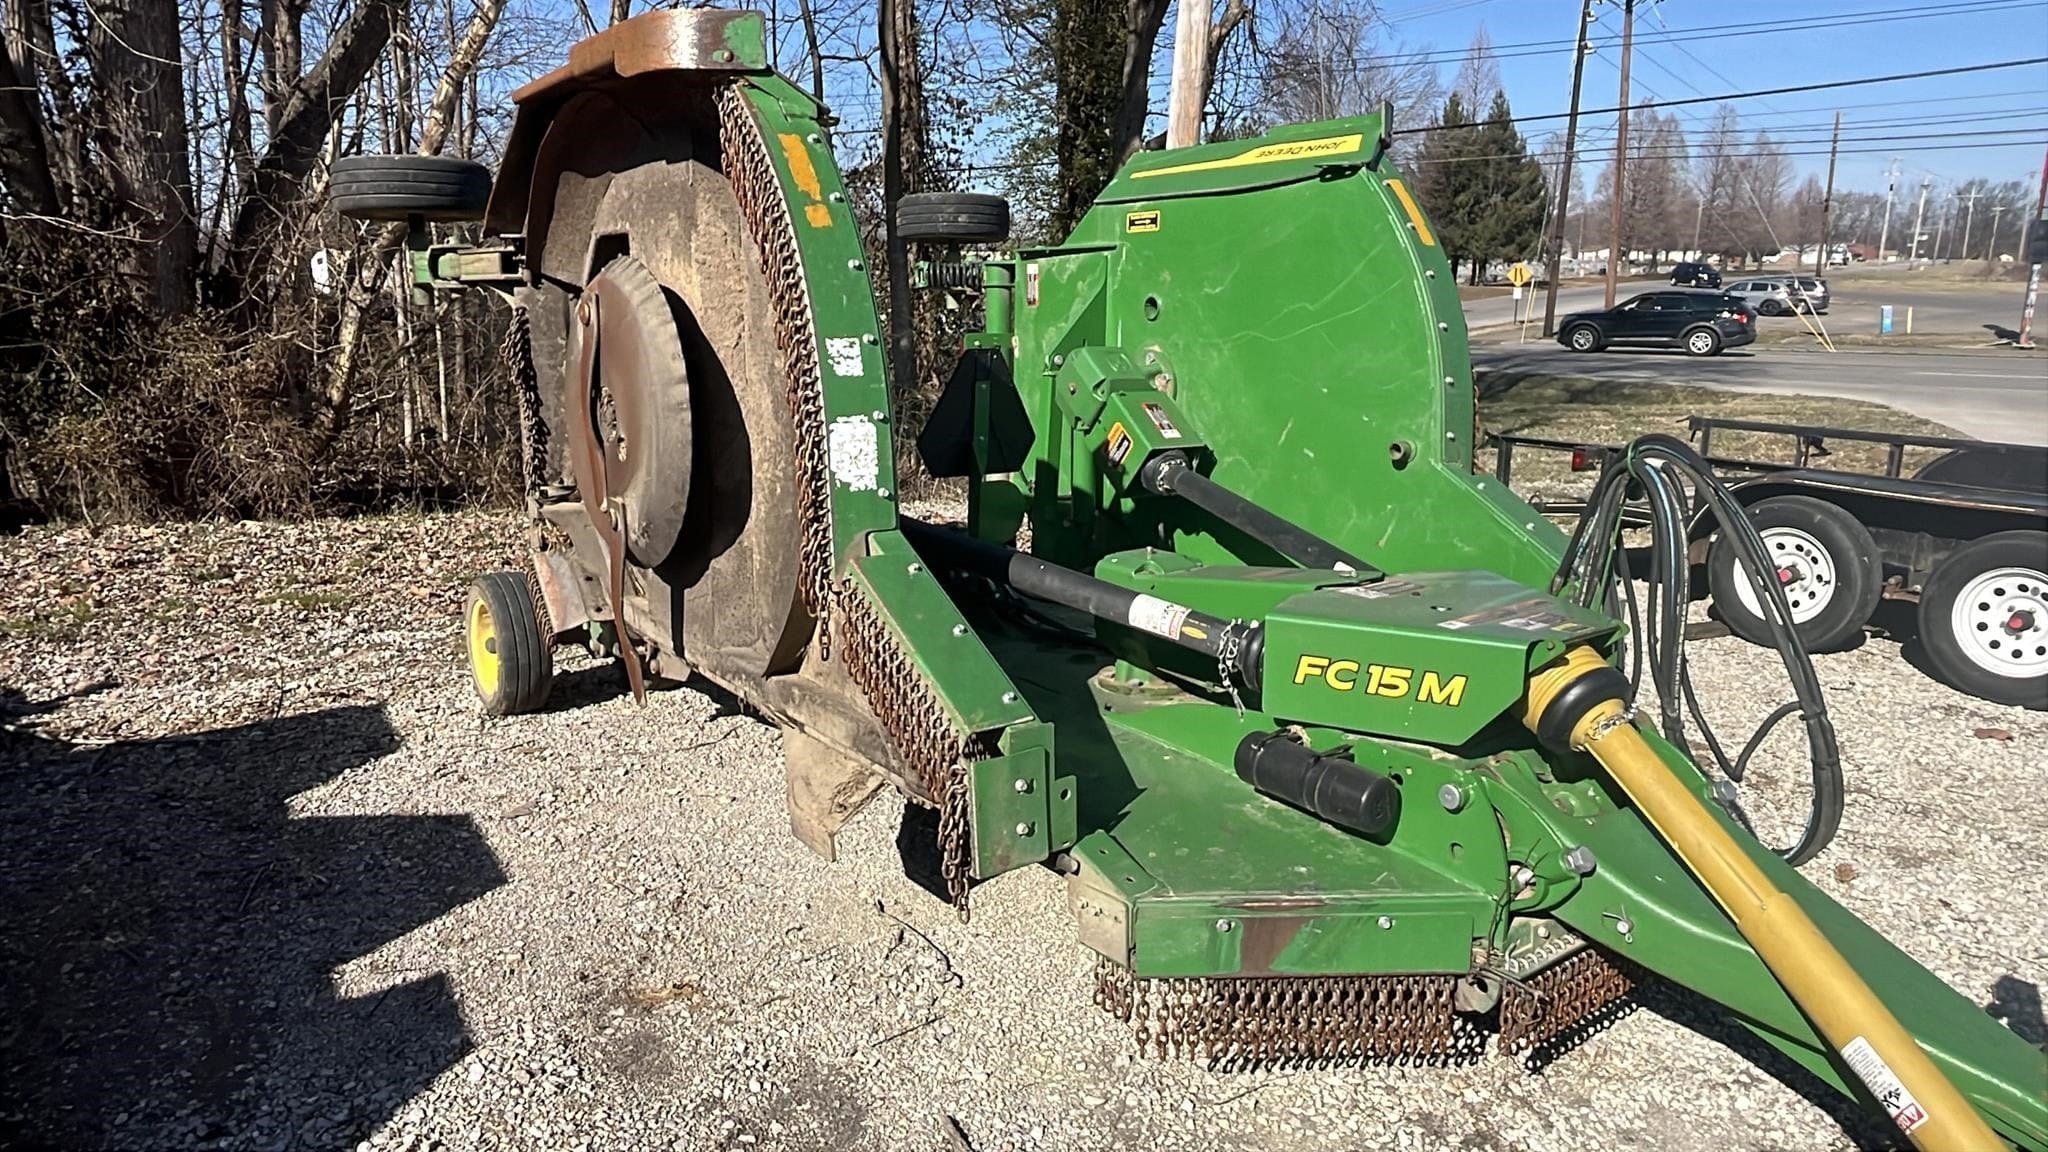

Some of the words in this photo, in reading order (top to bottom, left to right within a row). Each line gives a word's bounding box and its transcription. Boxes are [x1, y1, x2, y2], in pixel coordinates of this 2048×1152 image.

[1255, 146, 1304, 158] DEERE
[1305, 140, 1347, 152] JOHN
[1293, 654, 1360, 691] FC
[1365, 663, 1414, 698] 15
[1416, 670, 1469, 707] M
